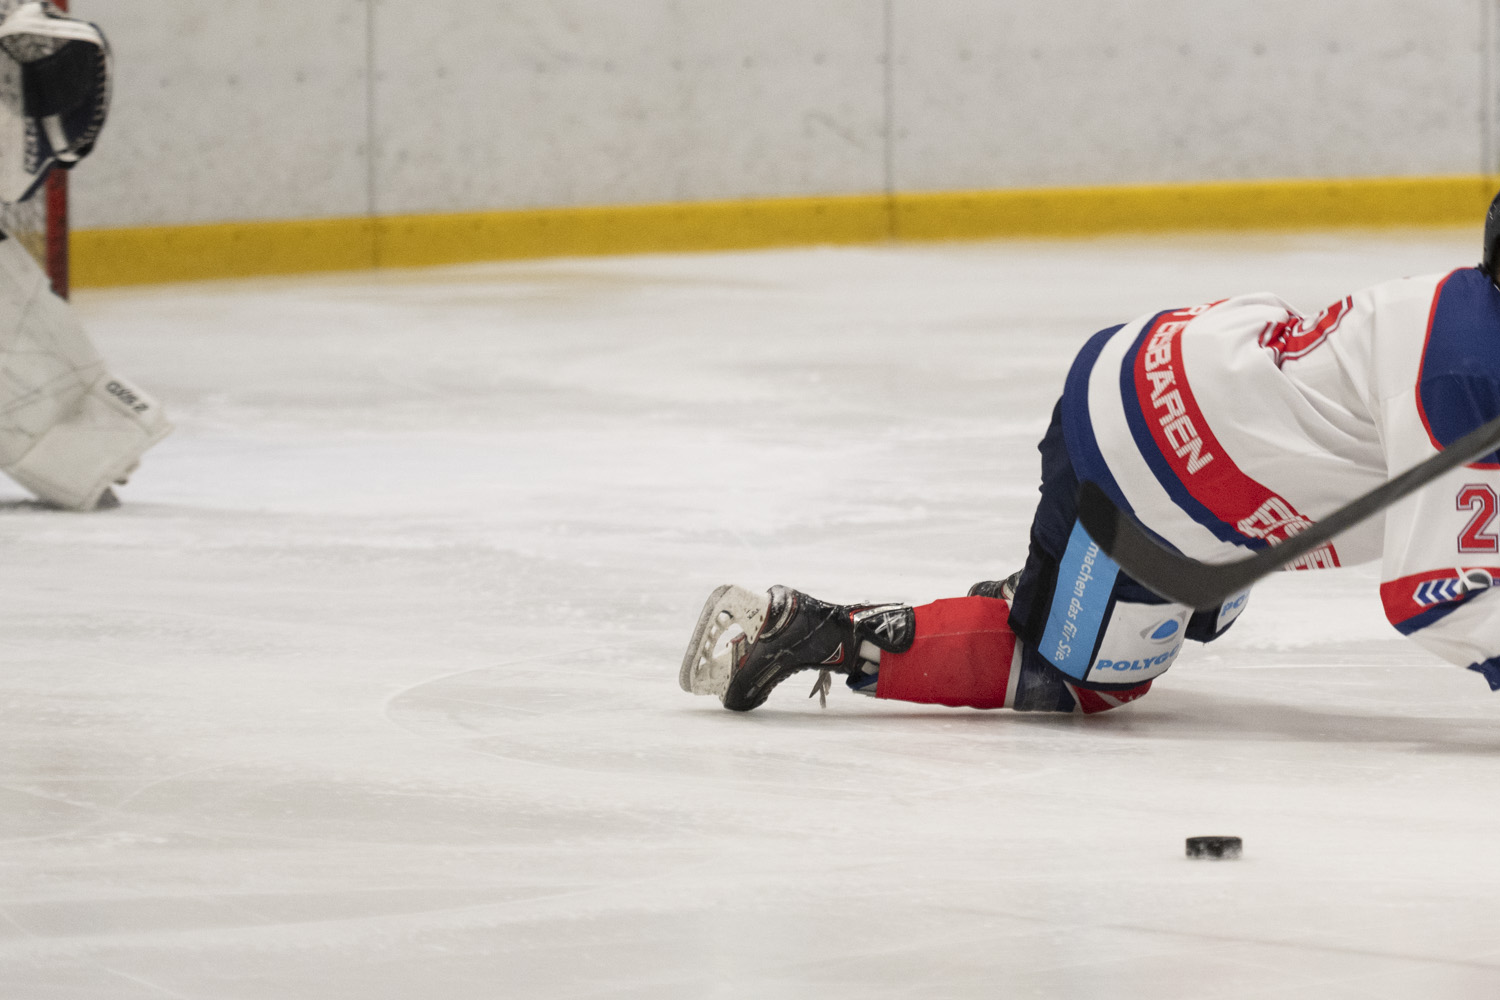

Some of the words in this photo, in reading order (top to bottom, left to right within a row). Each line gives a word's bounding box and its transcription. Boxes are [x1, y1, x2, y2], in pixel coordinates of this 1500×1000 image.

[1143, 320, 1215, 476] EISBÄREN
[1073, 541, 1101, 598] machen
[1067, 597, 1085, 621] das
[1062, 619, 1078, 643] für
[1053, 640, 1073, 663] Sie.
